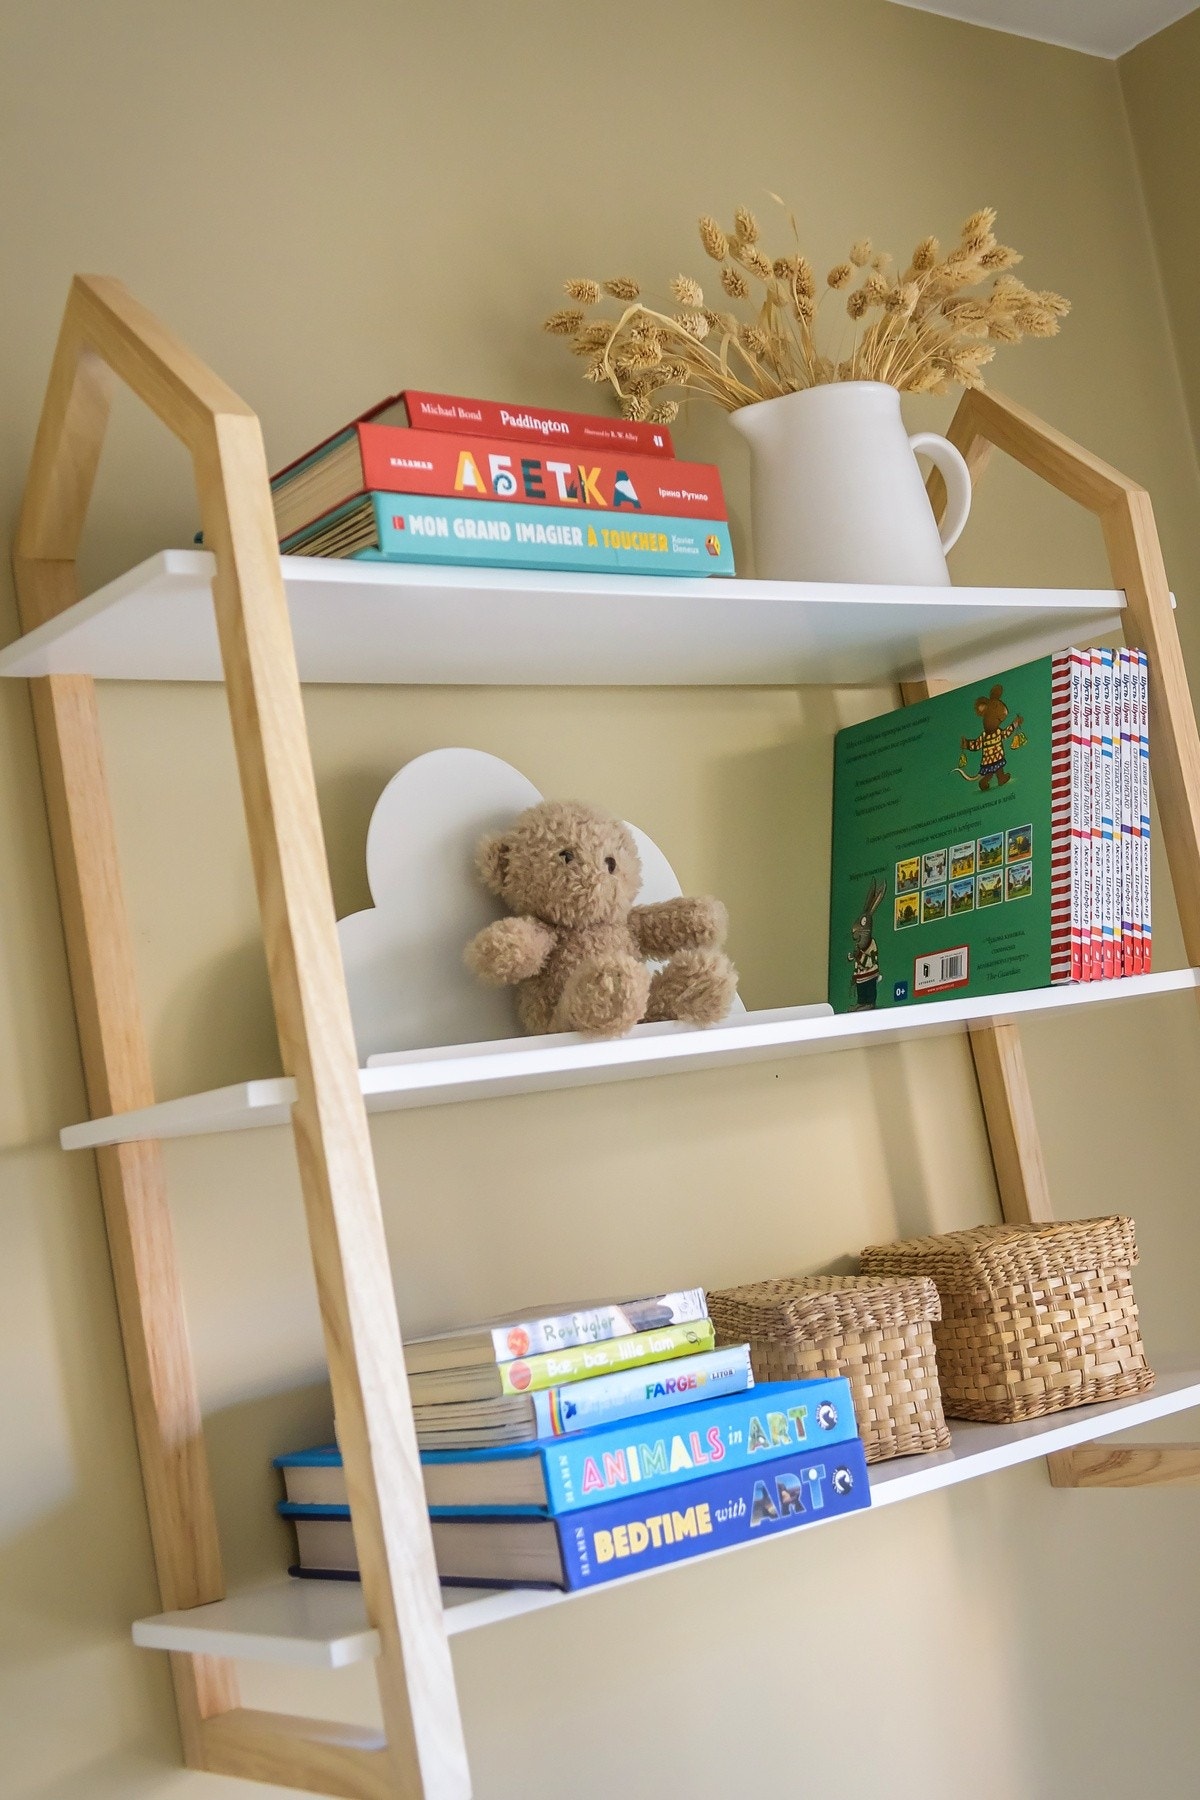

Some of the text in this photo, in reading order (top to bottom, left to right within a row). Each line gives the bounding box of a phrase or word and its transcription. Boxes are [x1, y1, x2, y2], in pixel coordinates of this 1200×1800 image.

[420, 402, 482, 421] Michael Bond
[500, 410, 570, 435] Paddington
[454, 451, 641, 509] АБЕТКА
[658, 487, 709, 502] Ірина Рутило
[408, 514, 669, 552] MON GRAND IMAGIER À TOUCHER
[1083, 707, 1091, 727] Шуня
[1103, 704, 1111, 725] Шуня
[895, 988, 906, 997] 0+
[543, 1314, 616, 1343] Rovfugler
[617, 1343, 645, 1361] lille
[650, 1337, 675, 1356] lam
[711, 1369, 735, 1381] LITOR
[582, 1426, 725, 1495] ANIMALS
[728, 1426, 743, 1446] in
[747, 1405, 808, 1454] ART
[558, 1454, 575, 1504] HAHN
[593, 1502, 713, 1564] BEDTIME
[715, 1497, 747, 1523] with
[750, 1463, 826, 1527] ART
[574, 1526, 591, 1577] HAHN
